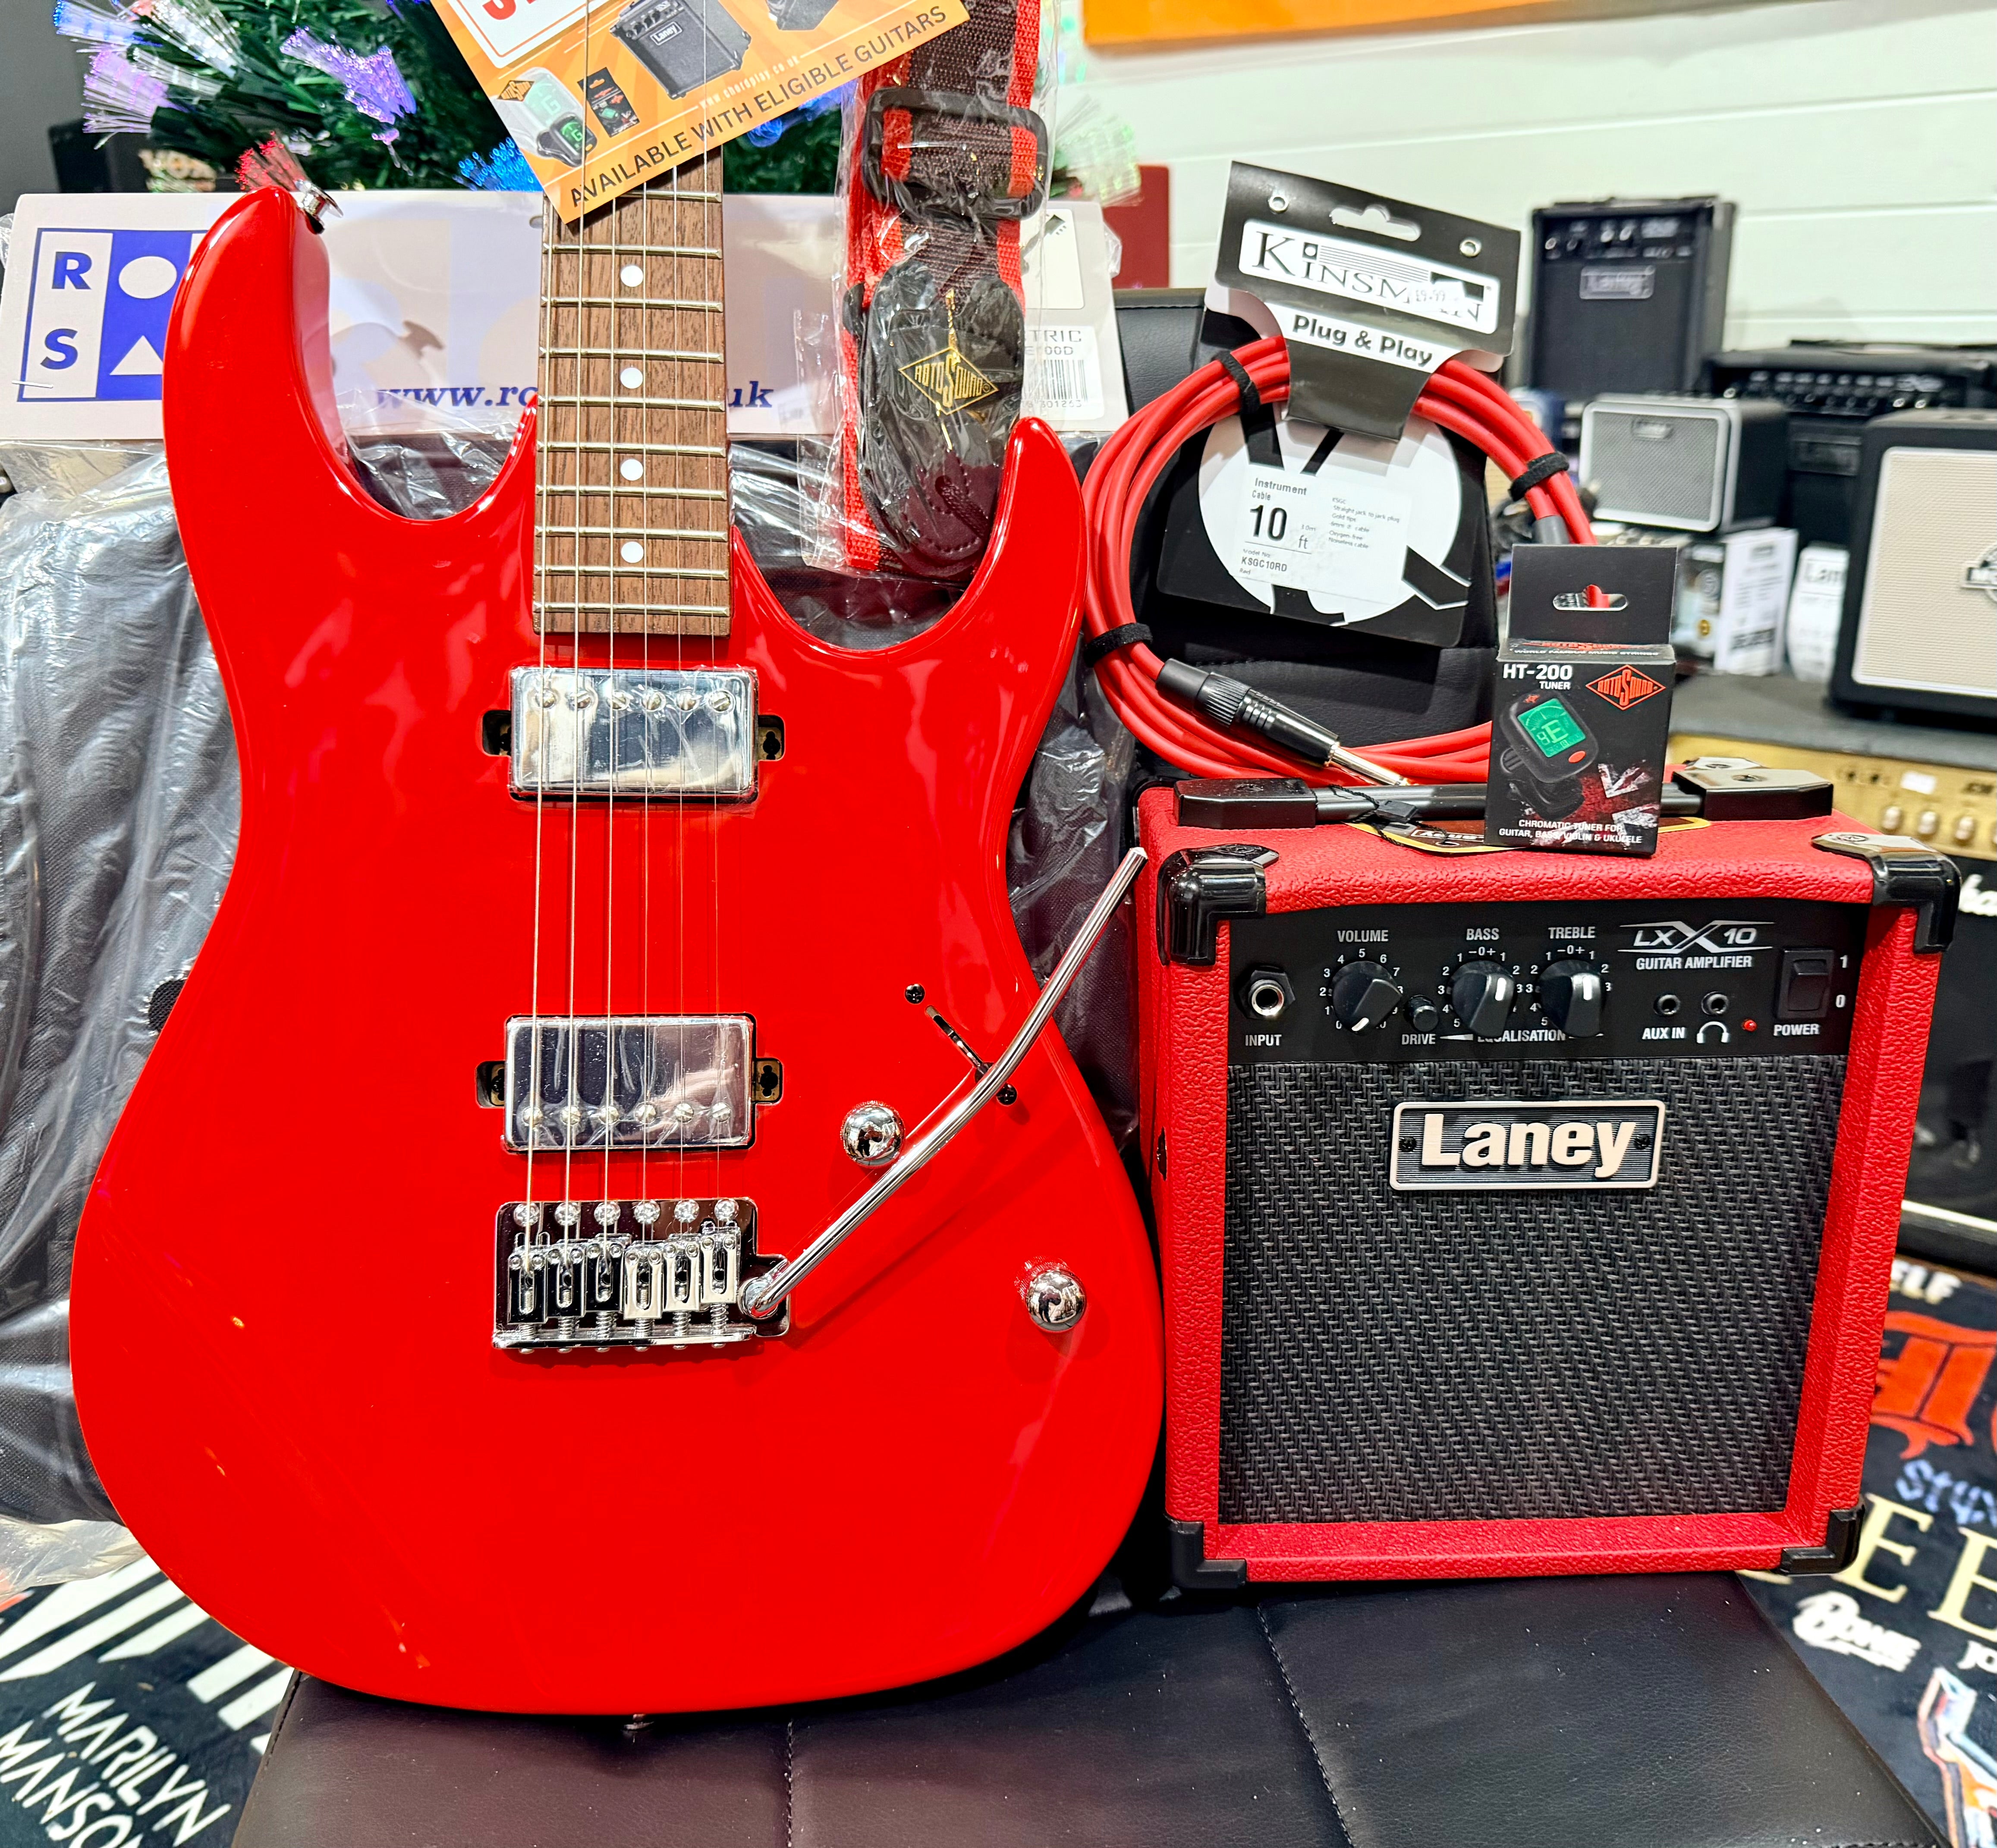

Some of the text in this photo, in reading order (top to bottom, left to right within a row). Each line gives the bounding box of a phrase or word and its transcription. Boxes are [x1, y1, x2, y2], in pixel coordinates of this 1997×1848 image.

[654, 23, 679, 42] Laney
[570, 6, 947, 207] AVAILABLE WITH ELIGIBLE GUITARS
[1294, 314, 1433, 366] Plug & Play
[1255, 477, 1307, 496] Instrument
[1252, 490, 1271, 501] Cable
[1333, 505, 1355, 514] Straight
[1249, 504, 1288, 542] 10
[1298, 534, 1308, 550] ft
[1241, 556, 1288, 572] KSGC10RD
[1503, 663, 1573, 681] HT-200
[1539, 680, 1571, 691] TUNER
[1518, 818, 1623, 833] CHROMATIC TUNER FOR
[1498, 827, 1534, 839] GUITAR,
[1563, 831, 1593, 842] VIOLIN
[1594, 833, 1602, 842] &
[1603, 834, 1643, 844] UKULELE
[1337, 929, 1389, 943] VOLUME
[1466, 927, 1500, 941] BASS
[1548, 926, 1596, 939] TREBLE
[1359, 949, 1366, 958] 5
[1380, 954, 1387, 963] 6
[1457, 952, 1463, 962] 1
[1500, 952, 1506, 962] 1
[1546, 951, 1552, 961] 1
[1589, 951, 1595, 960] 1
[1337, 954, 1344, 964] 4
[1636, 955, 1752, 971] GUITAR AMPLIFIER
[1840, 955, 1848, 969] 1
[1324, 968, 1330, 978] 3
[1393, 967, 1400, 976] 7
[1442, 966, 1450, 976] 2
[1512, 965, 1520, 975] 2
[1530, 965, 1539, 975] 2
[1601, 964, 1610, 974] 2
[1319, 987, 1327, 996] 2
[1437, 985, 1445, 995] 3
[1516, 984, 1523, 993] 3
[1525, 984, 1533, 993] 3
[1605, 982, 1613, 992] 3
[1835, 994, 1846, 1008] 0
[1324, 1006, 1330, 1015] 1
[1442, 1004, 1450, 1014] 4
[1529, 1003, 1538, 1012] 4
[1453, 1018, 1460, 1028] 5
[1541, 1017, 1548, 1026] 5
[1642, 1027, 1685, 1040] AUX IN
[1774, 1024, 1820, 1036] POWER
[1245, 1034, 1282, 1047] INPUT
[1401, 1033, 1437, 1045] DRIVE
[1421, 1113, 1637, 1179] Laney
[42, 1681, 232, 1847] MARILYN
